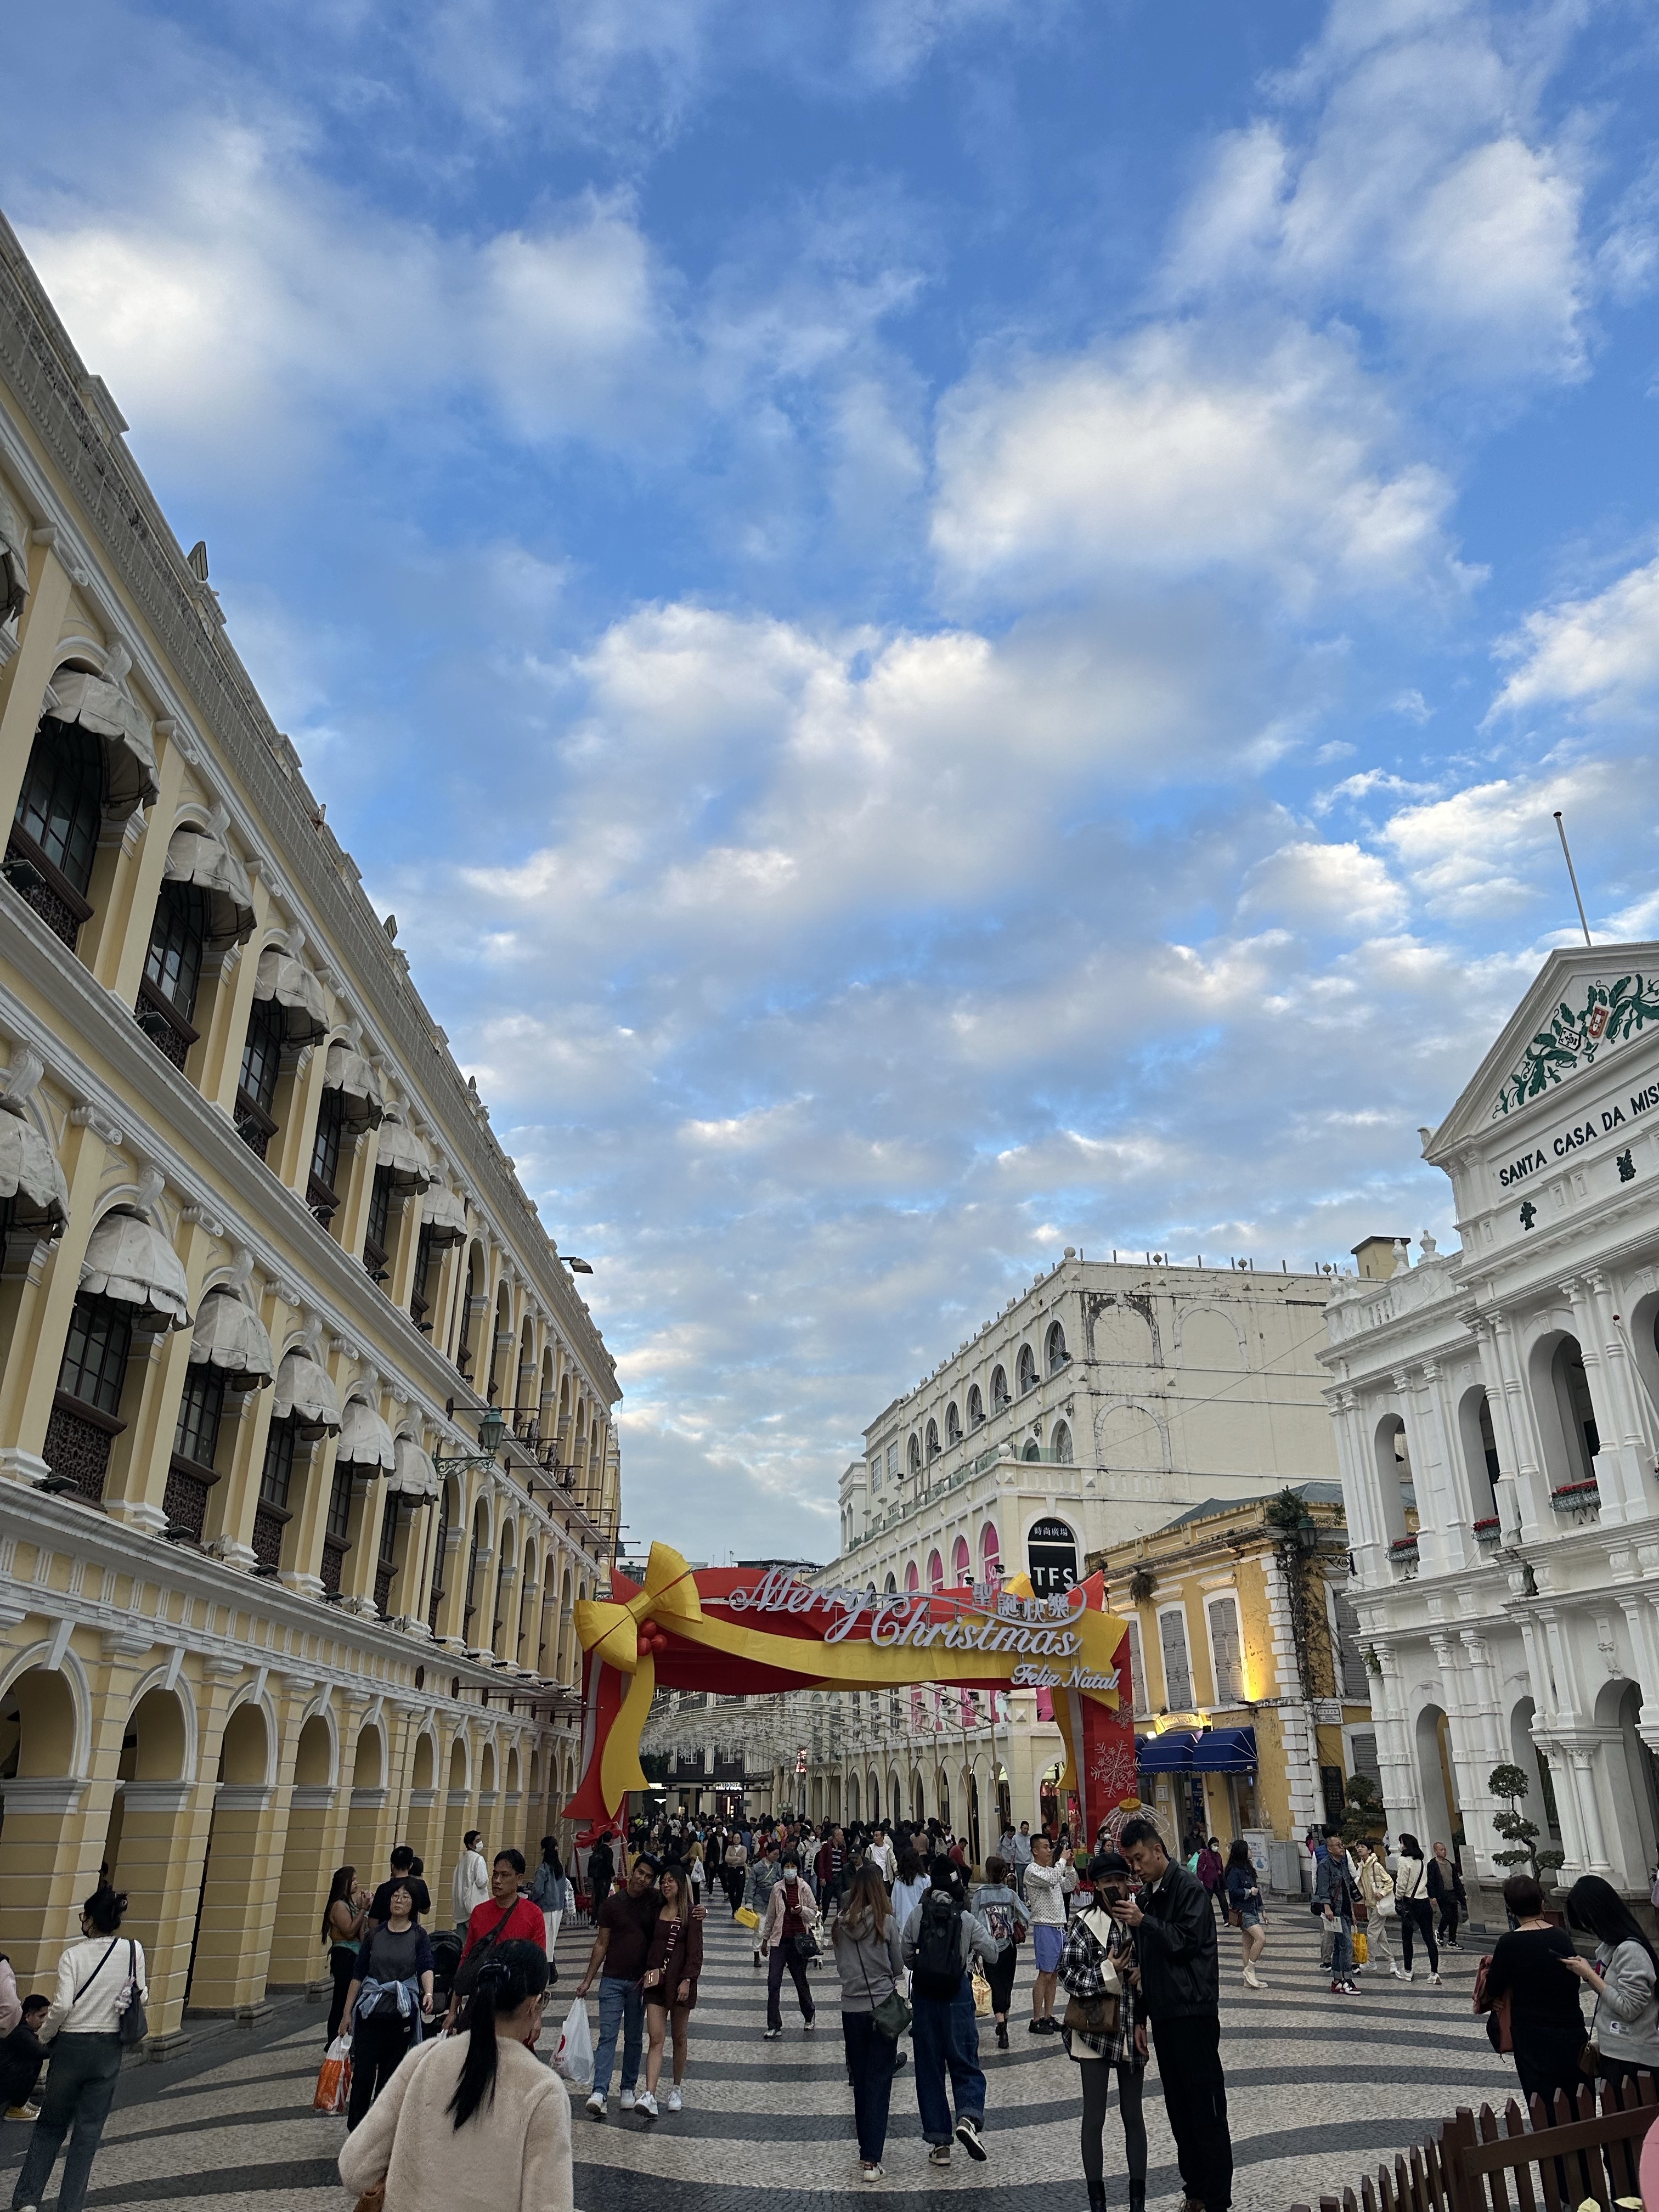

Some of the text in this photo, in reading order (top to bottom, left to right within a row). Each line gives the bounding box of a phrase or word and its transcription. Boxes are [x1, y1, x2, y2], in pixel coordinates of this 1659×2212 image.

[1499, 1082, 1659, 1186] SANTA CASA DA MIS
[1034, 1526, 1068, 1536] 時尚廣場
[1033, 1567, 1074, 1586] TFS
[729, 1565, 874, 1643] Merry
[972, 1582, 1069, 1622] 聖誕快樂
[871, 1599, 1083, 1656] Christmas
[1011, 1663, 1121, 1690] Feliz Natal
